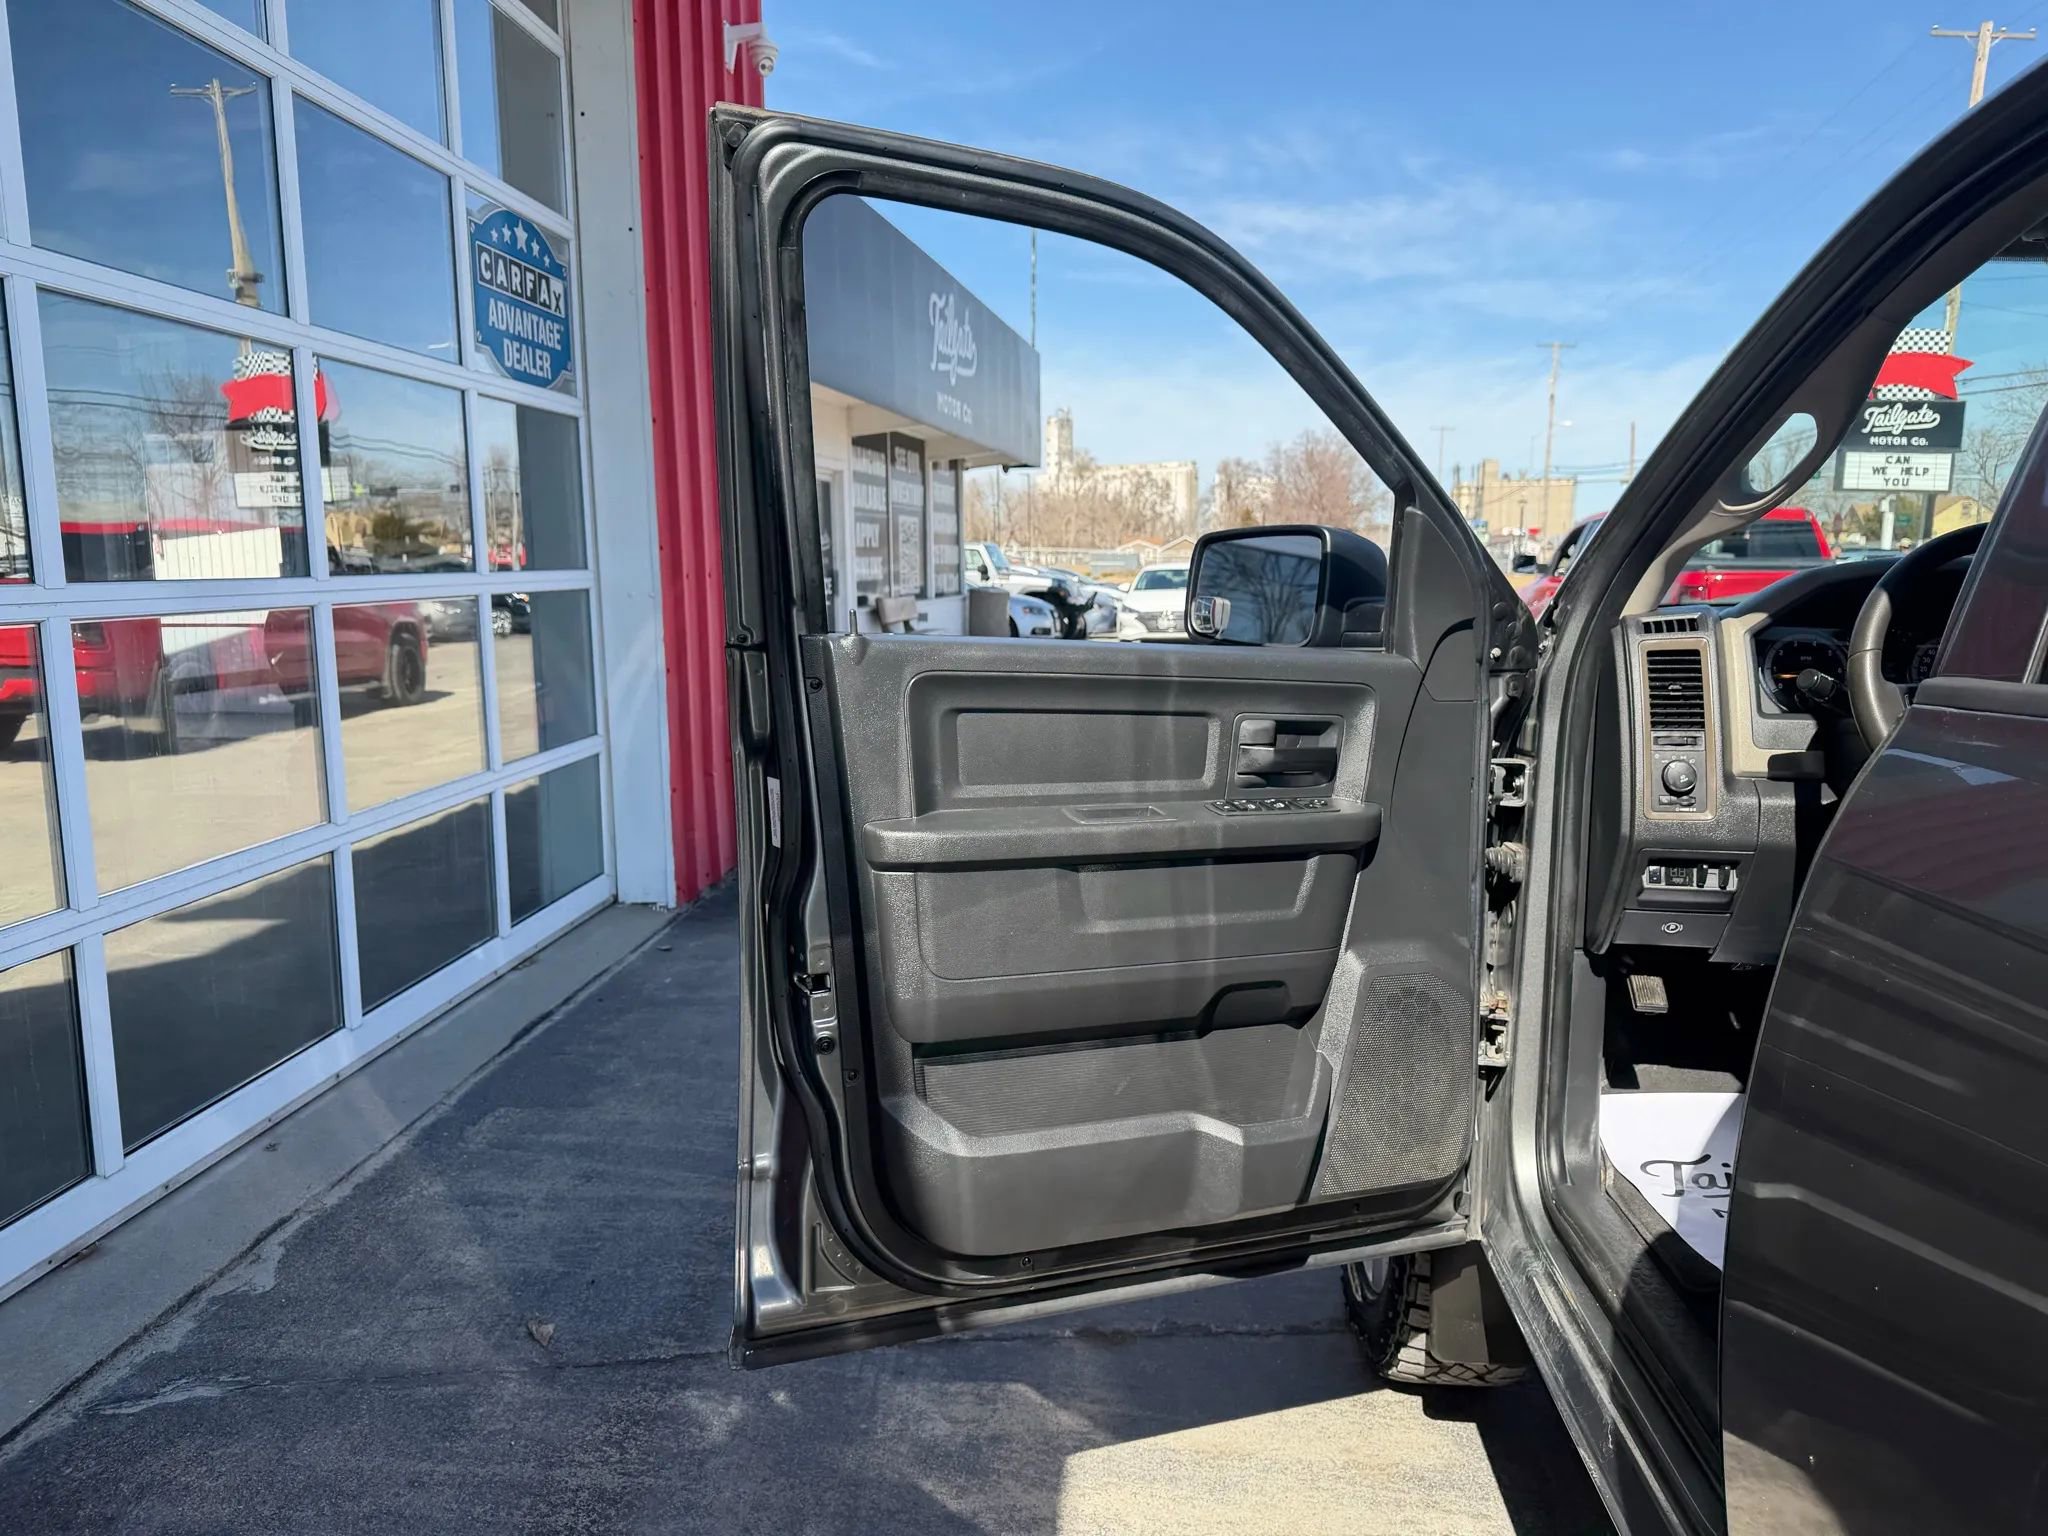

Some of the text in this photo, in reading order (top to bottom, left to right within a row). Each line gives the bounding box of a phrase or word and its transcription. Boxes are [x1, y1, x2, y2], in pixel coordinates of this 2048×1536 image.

[479, 251, 563, 315] CARFAX
[488, 298, 563, 350] ADVANTAGE
[503, 340, 552, 380] DEALER
[1861, 402, 1941, 435] Tailgate
[1869, 436, 1929, 446] MOTOR CO.
[1885, 455, 1911, 465] CAN
[1872, 466, 1930, 477] WE HELP
[1884, 478, 1910, 487] YOU
